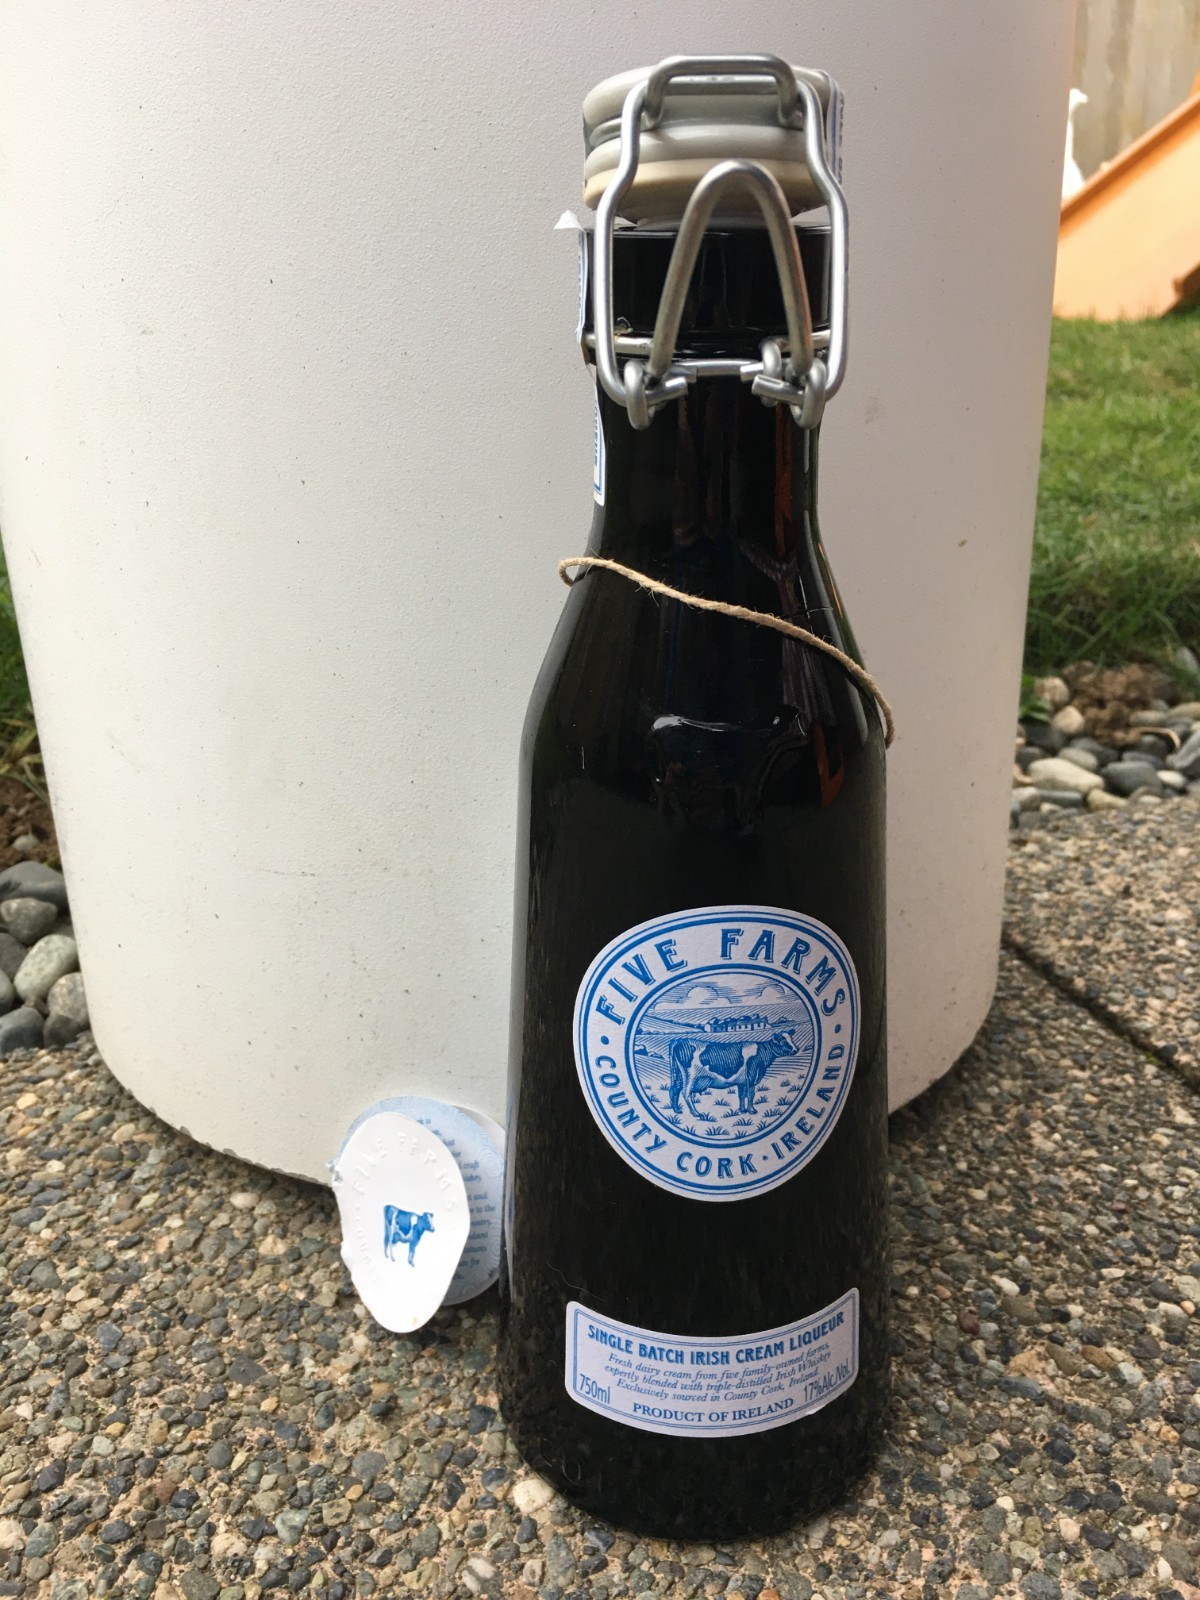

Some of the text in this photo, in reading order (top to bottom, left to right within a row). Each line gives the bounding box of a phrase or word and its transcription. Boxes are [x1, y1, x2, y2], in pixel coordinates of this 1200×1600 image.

[596, 929, 846, 1026] FIVE FARMS
[595, 1044, 845, 1179] COUNTY CORK IRELAND
[588, 1312, 845, 1365] SINGLE BATCH IRISH CREAM LIQUEUR
[605, 1365, 640, 1382] expertly
[642, 1374, 677, 1389] blended
[681, 1381, 703, 1391] with
[706, 1374, 773, 1393] triple-distilled
[775, 1367, 796, 1382] Irish
[608, 1353, 632, 1368] Fresh
[635, 1362, 661, 1376] dairy
[663, 1370, 691, 1379] cream
[692, 1370, 717, 1383] from
[718, 1370, 740, 1382] five
[741, 1352, 804, 1380] family-owned
[579, 1373, 611, 1404] 750ml
[616, 1378, 669, 1400] Exclusively
[671, 1392, 708, 1402] sourced
[710, 1393, 720, 1402] in
[724, 1391, 758, 1401] County
[633, 1398, 794, 1422] PRODUCT OF IRELAND
